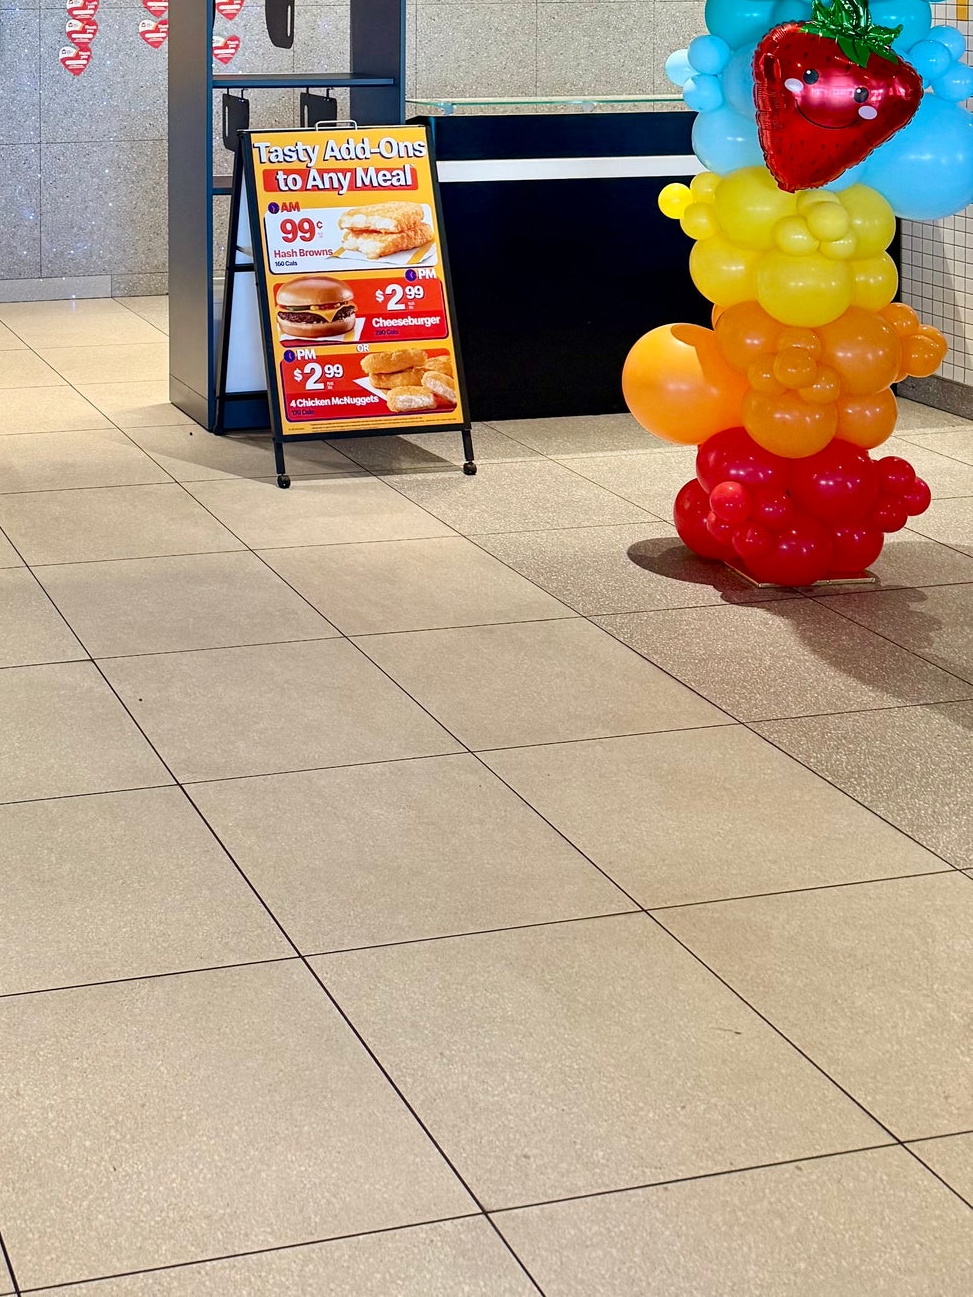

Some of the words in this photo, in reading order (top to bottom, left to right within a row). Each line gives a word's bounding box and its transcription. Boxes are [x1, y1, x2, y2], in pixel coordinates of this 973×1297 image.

[253, 142, 319, 167] Tasty
[324, 137, 426, 161] Add-Ons
[276, 170, 302, 191] to
[306, 166, 351, 195] Any
[355, 164, 412, 188] Meal
[281, 202, 300, 213] AM
[274, 249, 298, 258] Hash
[299, 248, 333, 257] Browns
[418, 269, 437, 280] PM
[372, 316, 441, 328] Cheeseburger
[356, 344, 369, 352] OR
[296, 349, 316, 361] PM
[290, 398, 296, 406] 4
[297, 396, 331, 408] Chicken
[331, 394, 379, 406] McNuggets
